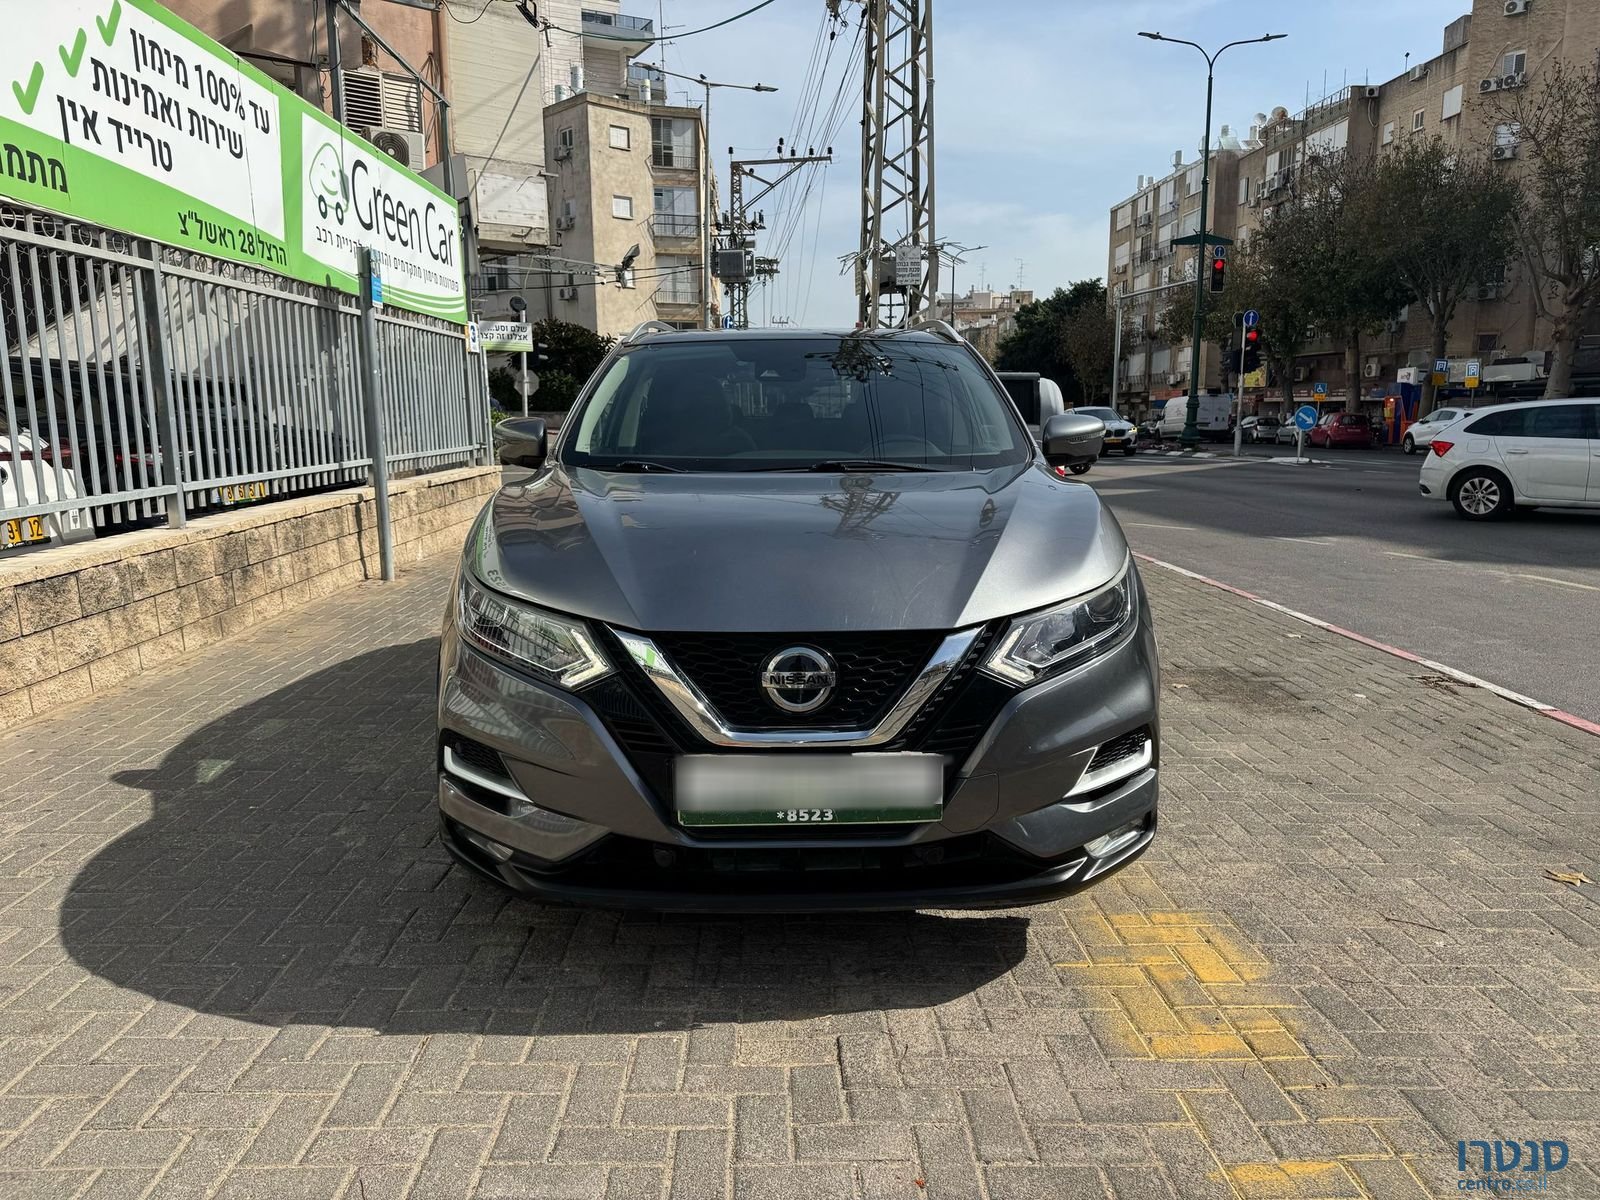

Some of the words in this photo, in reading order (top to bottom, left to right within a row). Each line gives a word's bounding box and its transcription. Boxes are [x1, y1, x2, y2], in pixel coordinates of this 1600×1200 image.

[130, 28, 189, 90] מימון
[90, 56, 183, 131] ואמינות
[195, 64, 246, 121] 100%
[249, 99, 270, 134] עד
[57, 95, 102, 144] אין
[108, 116, 173, 172] טרייד
[188, 107, 243, 159] שירות
[0, 143, 68, 193] מתמ
[178, 210, 236, 250] ראשל"צ
[316, 226, 333, 245] רכב
[351, 159, 422, 253] Green
[425, 202, 454, 267] Car
[239, 229, 255, 256] 28
[257, 234, 287, 266] הרצל
[769, 675, 829, 685] NISSAN
